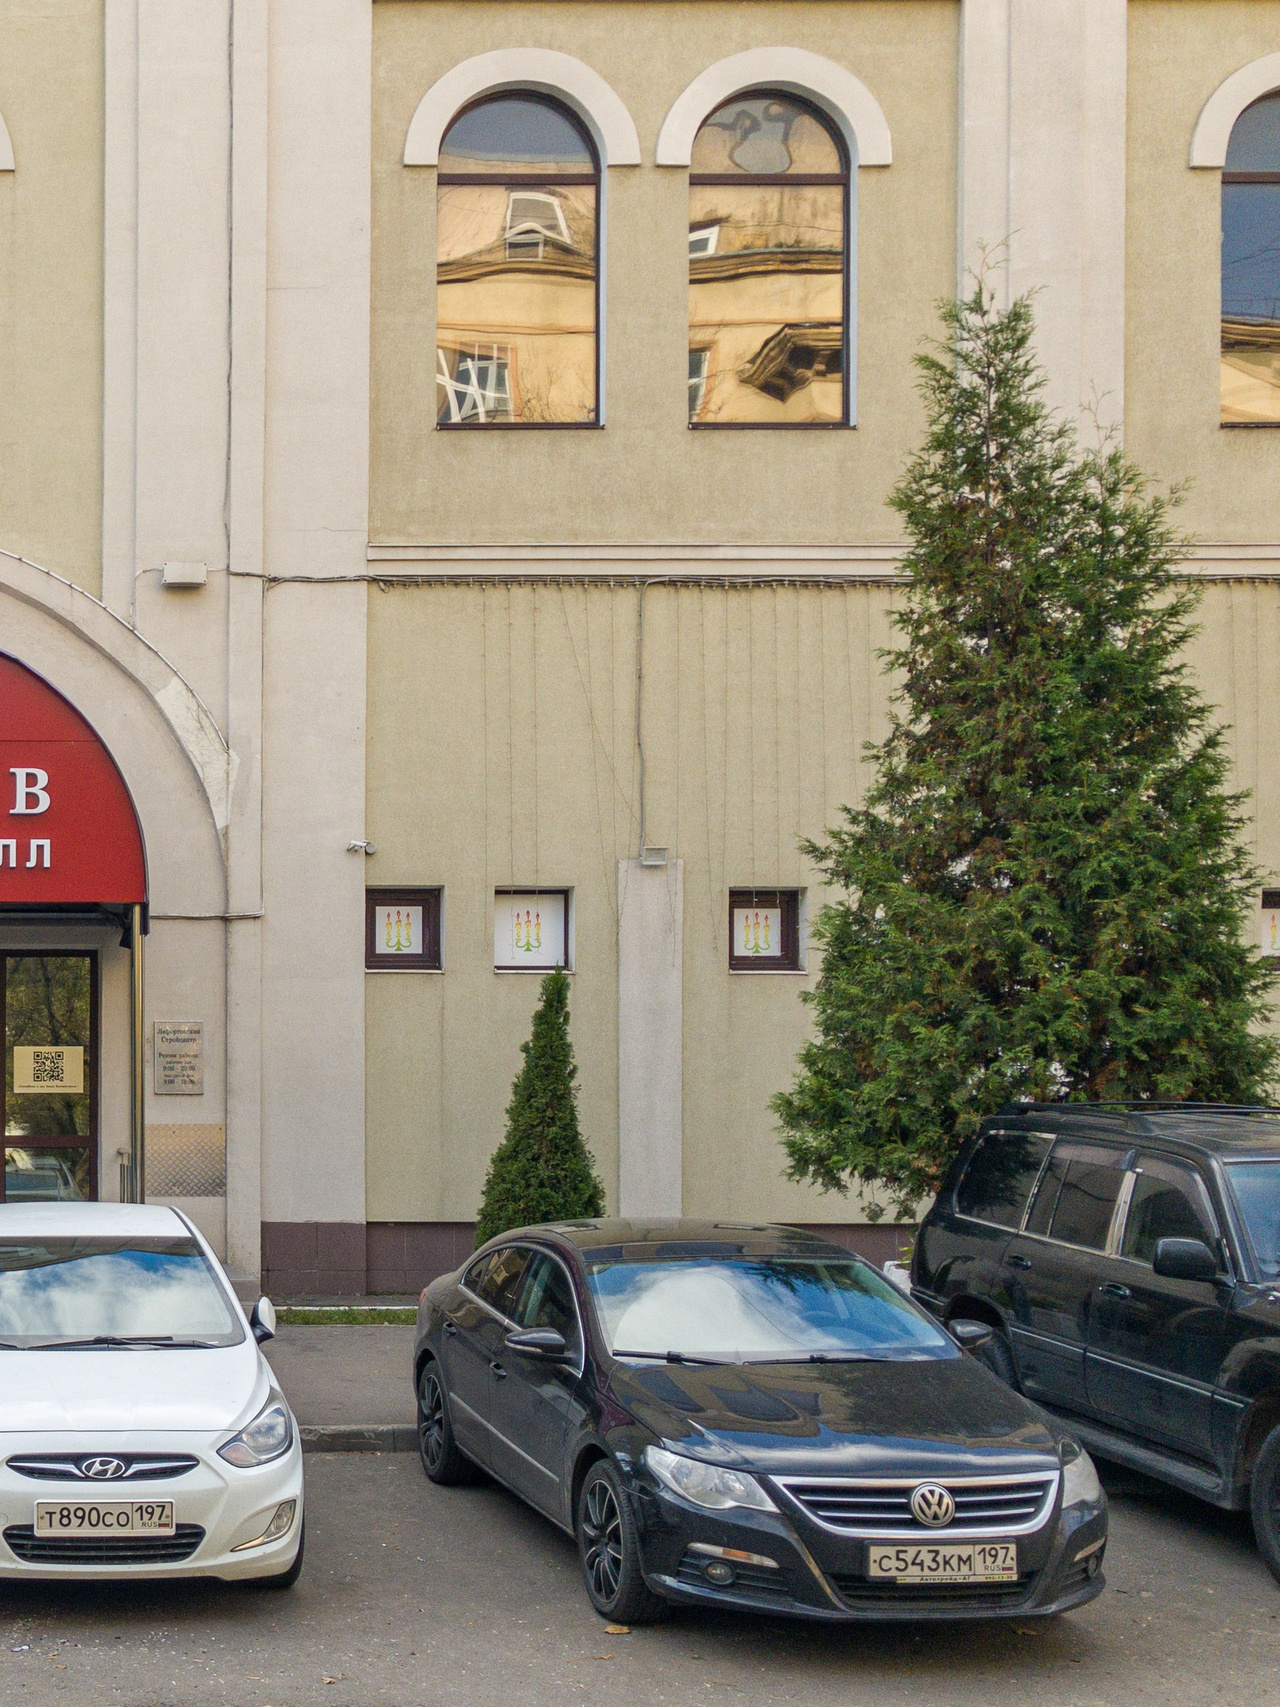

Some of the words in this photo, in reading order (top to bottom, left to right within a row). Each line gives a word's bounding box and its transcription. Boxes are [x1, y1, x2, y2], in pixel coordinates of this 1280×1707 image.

[45, 1506, 130, 1528] Т890СО
[135, 1505, 166, 1521] 197
[878, 1549, 972, 1573] С543КМ
[977, 1546, 1010, 1565] 197
[984, 1564, 1001, 1572] RUS
